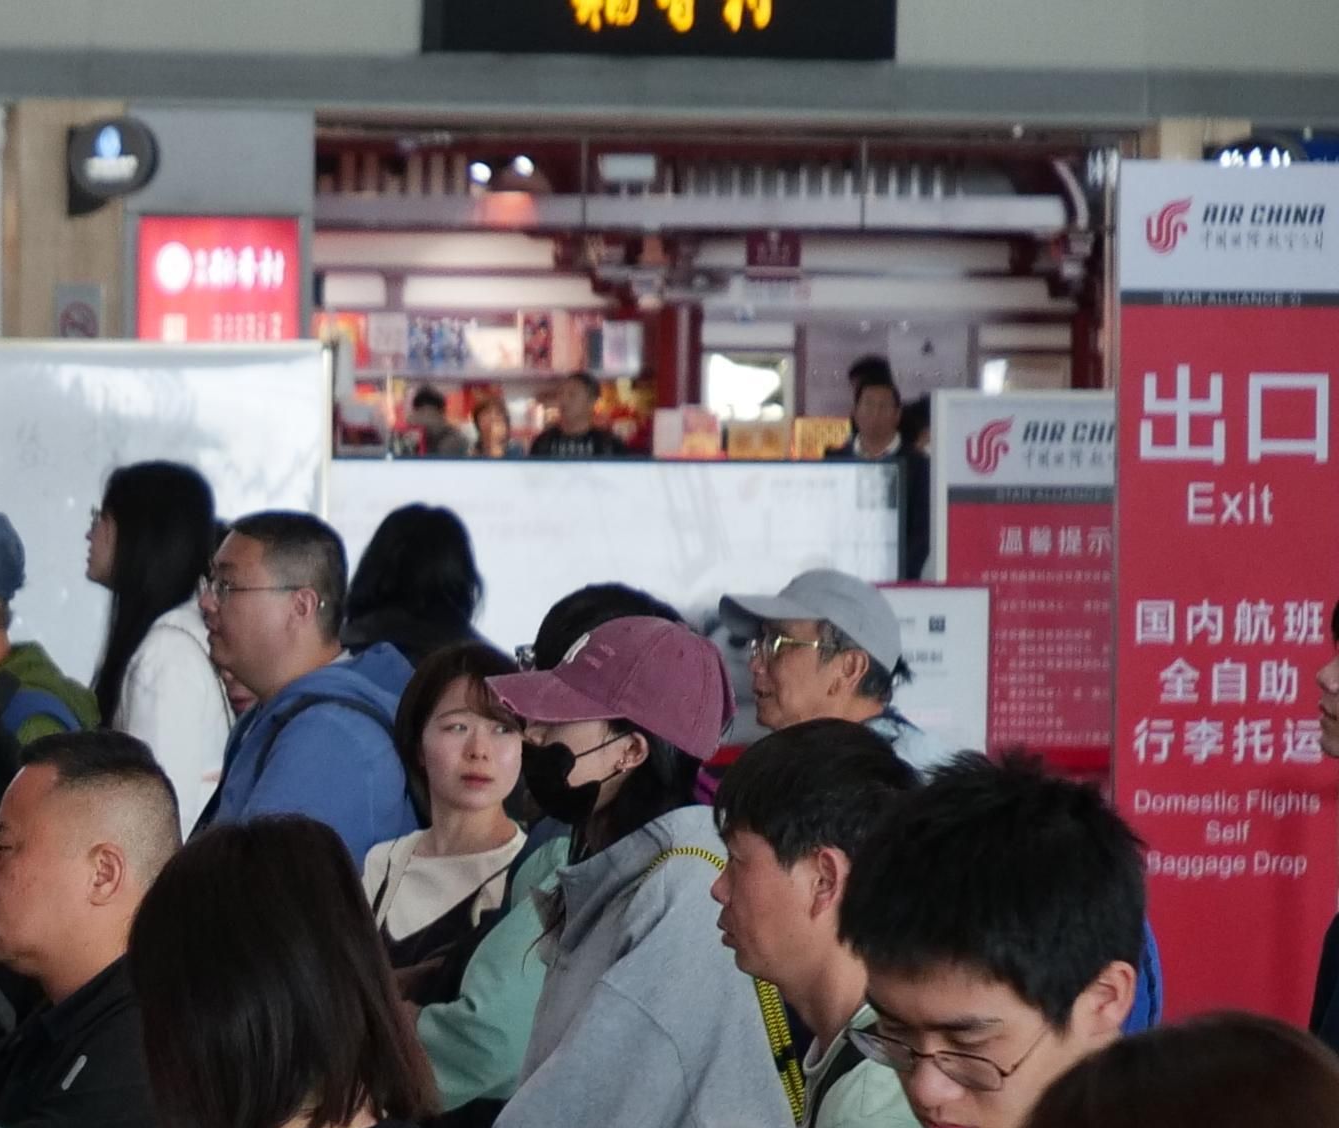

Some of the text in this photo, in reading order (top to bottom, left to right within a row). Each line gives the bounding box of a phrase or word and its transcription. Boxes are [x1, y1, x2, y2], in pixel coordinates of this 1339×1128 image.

[1203, 204, 1325, 225] AIR CHINA
[1139, 363, 1329, 464] 出口
[1023, 420, 1115, 443] AIR CHI
[1187, 481, 1273, 526] Exit
[998, 526, 1112, 557] 温馨提示
[1136, 600, 1324, 645] 国内航班
[1159, 658, 1299, 704] 全自助
[1134, 717, 1323, 764] 行李托运
[1134, 790, 1320, 817] Domestic Flights
[1205, 819, 1249, 843] Self
[1146, 851, 1307, 878] Baggage Drop
